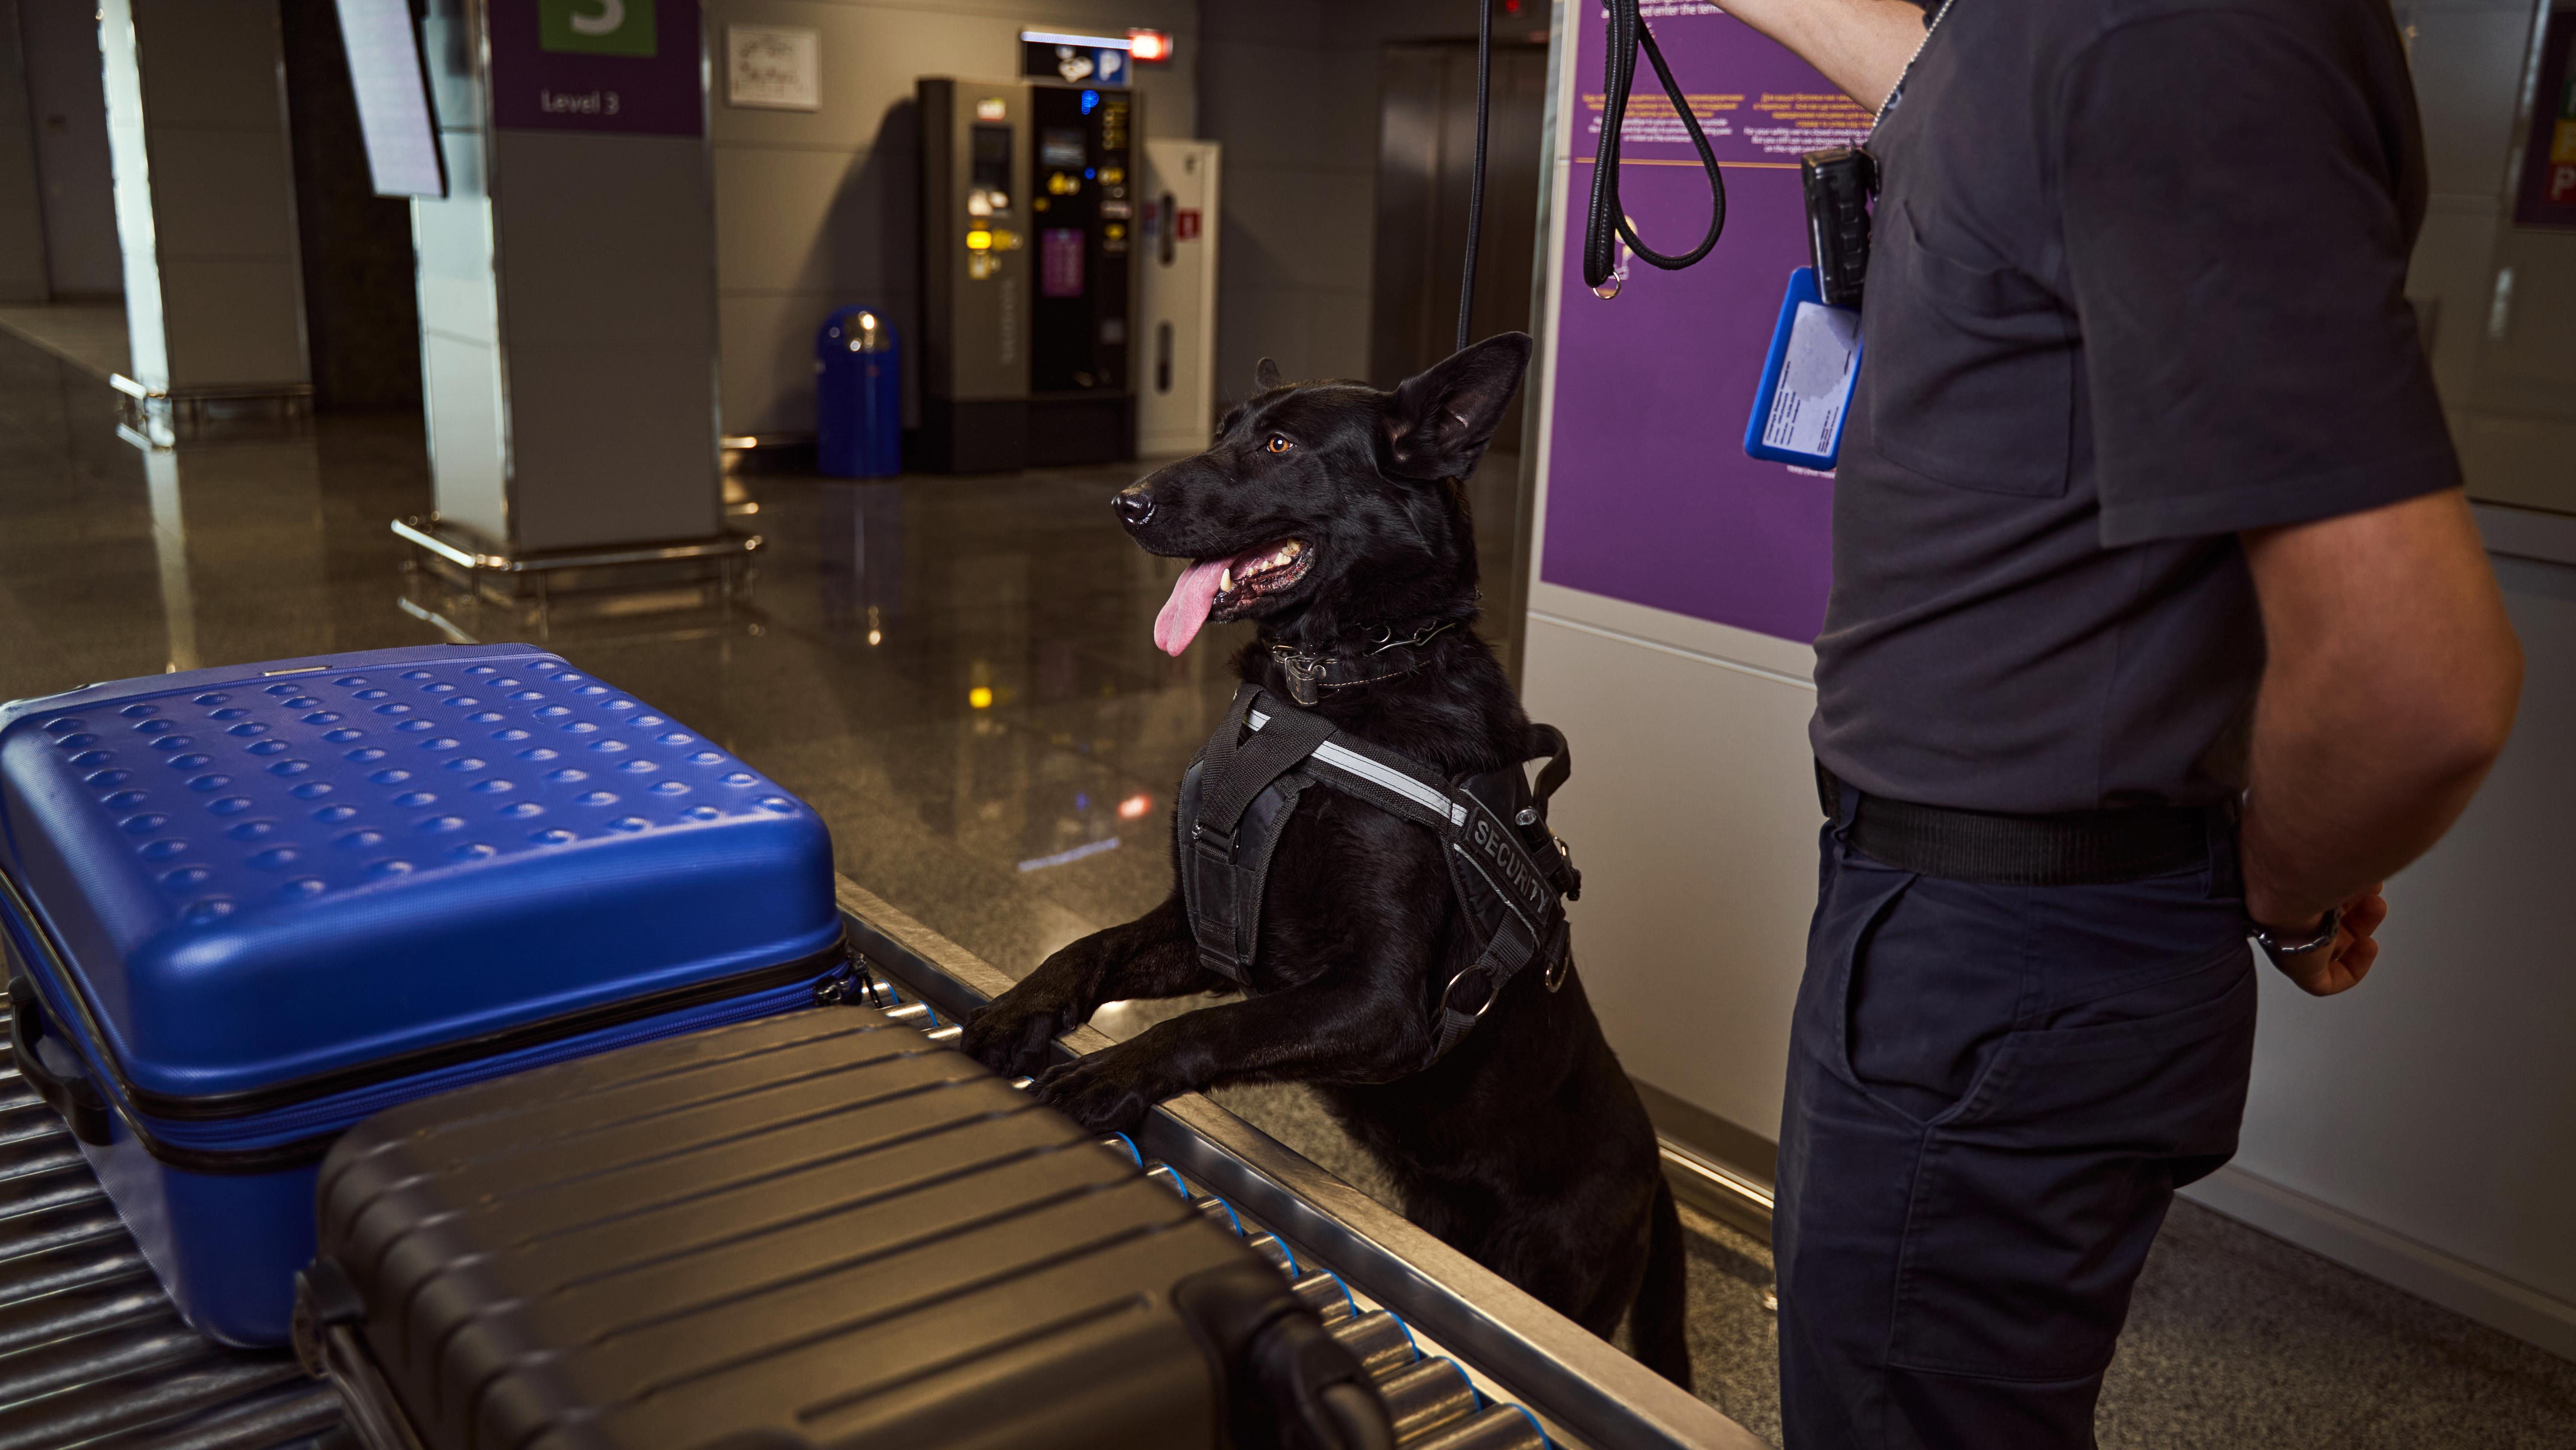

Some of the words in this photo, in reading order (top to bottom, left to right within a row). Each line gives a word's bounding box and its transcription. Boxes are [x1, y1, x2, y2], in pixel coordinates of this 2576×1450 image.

[1654, 5, 1678, 16] enter
[1680, 4, 1697, 15] the
[541, 88, 600, 113] Level
[604, 91, 619, 115] 3
[1475, 820, 1549, 913] SECURITY
